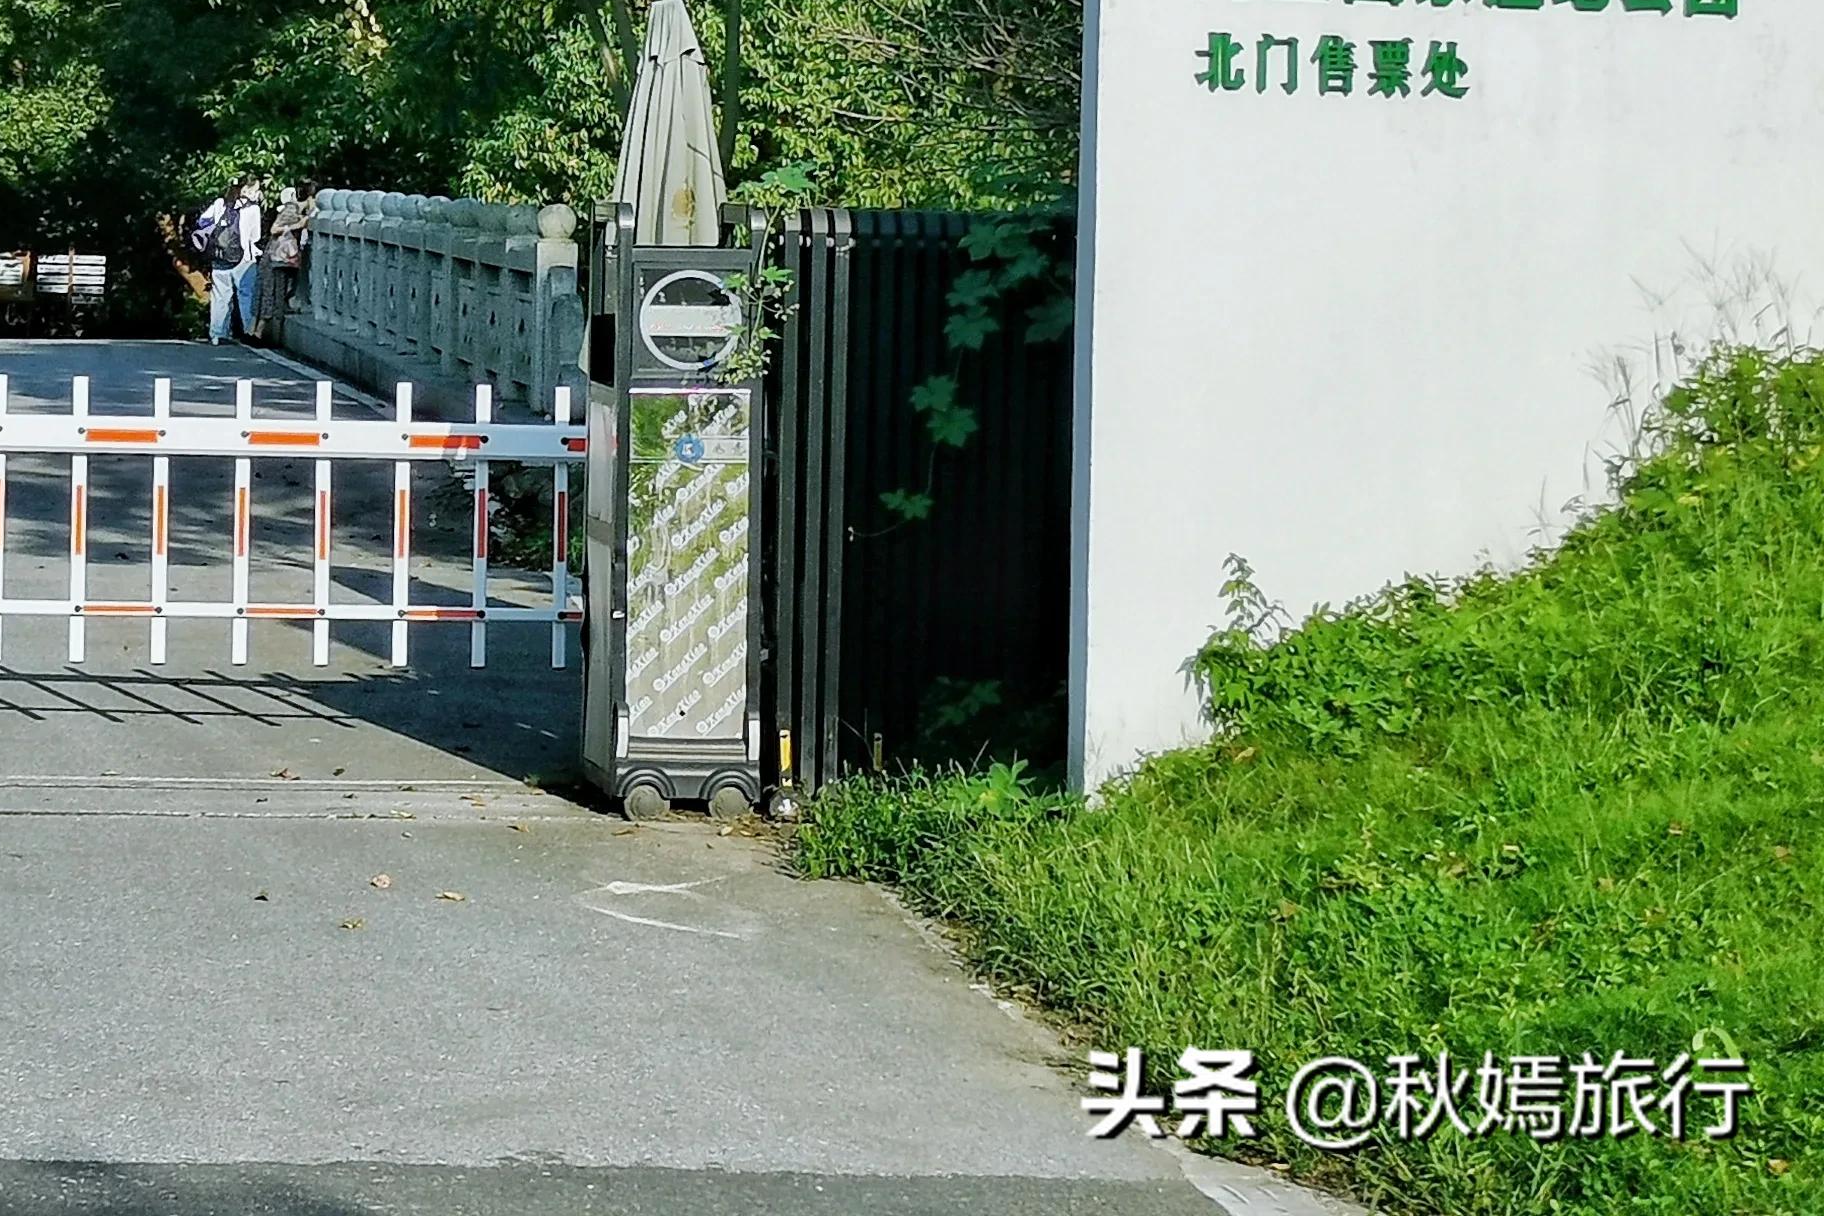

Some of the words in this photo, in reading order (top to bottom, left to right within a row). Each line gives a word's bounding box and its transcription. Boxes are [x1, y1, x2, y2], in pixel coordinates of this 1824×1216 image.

[1194, 32, 1471, 98] 北门售票处
